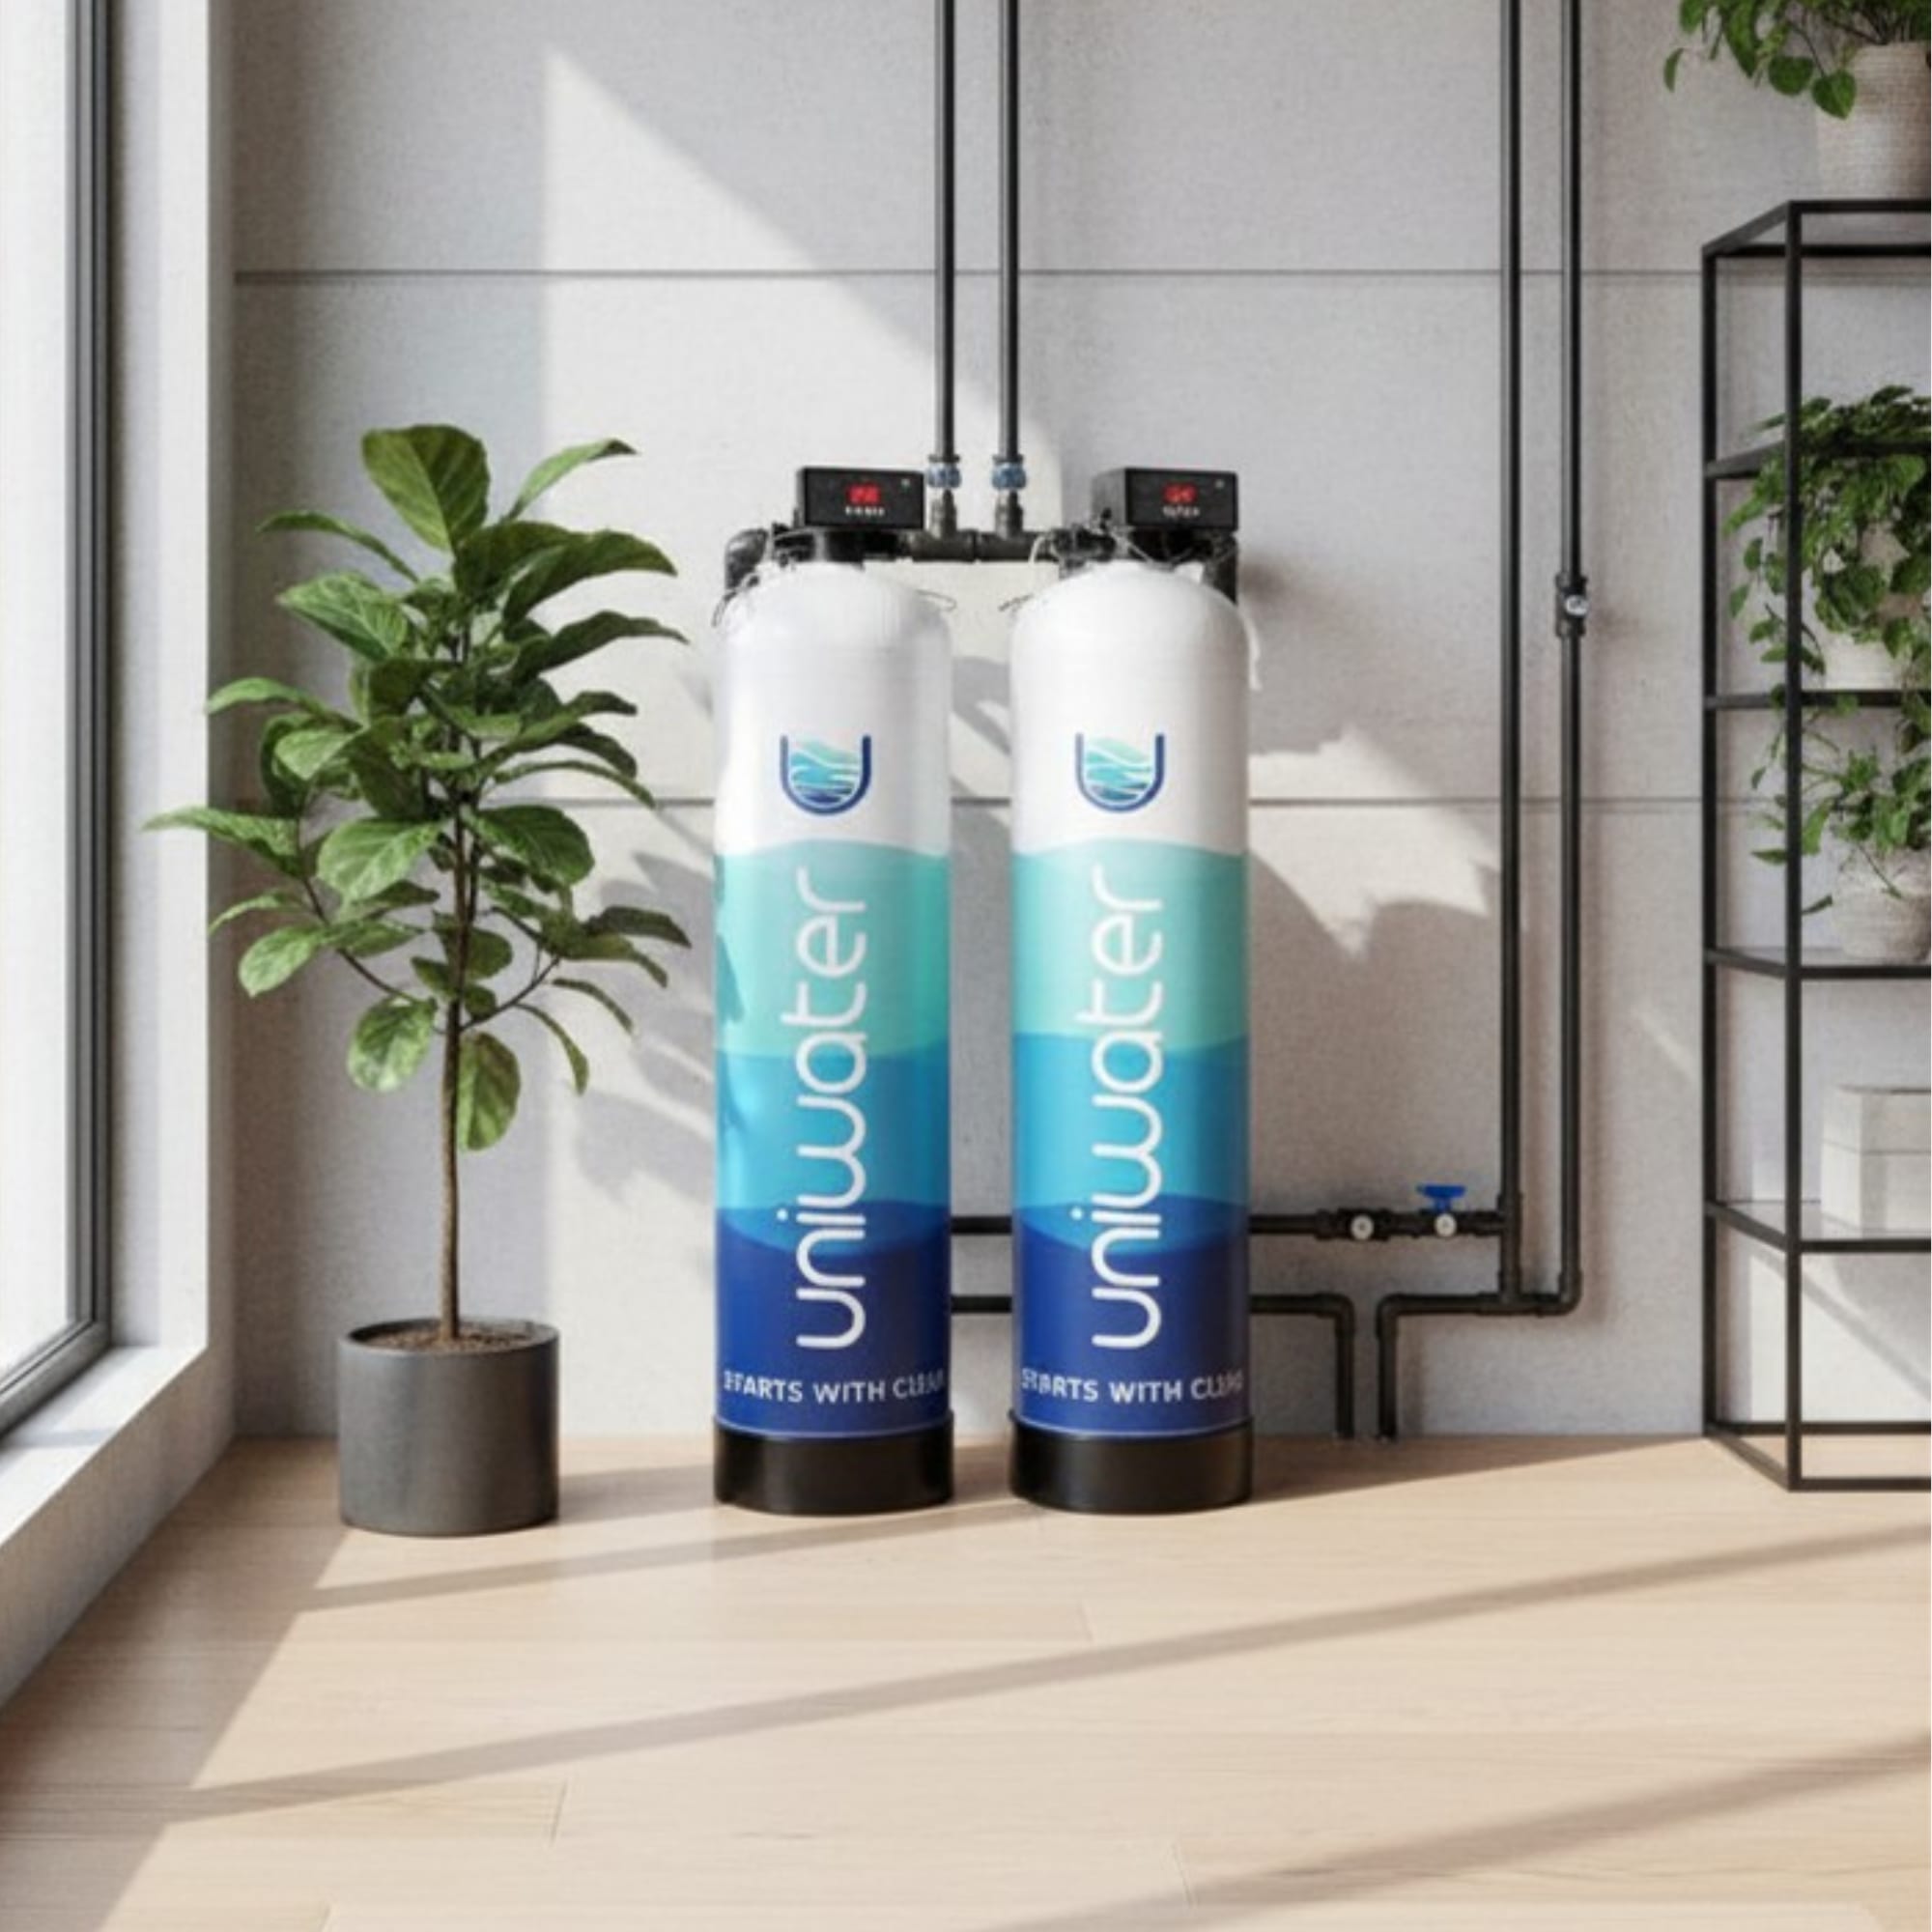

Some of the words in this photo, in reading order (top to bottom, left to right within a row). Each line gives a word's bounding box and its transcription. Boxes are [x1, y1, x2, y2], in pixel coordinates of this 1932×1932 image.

[777, 866, 867, 1349] uniwater
[1072, 863, 1163, 1349] uniwater
[812, 1380, 886, 1404] WITH
[1108, 1379, 1182, 1404] WITH
